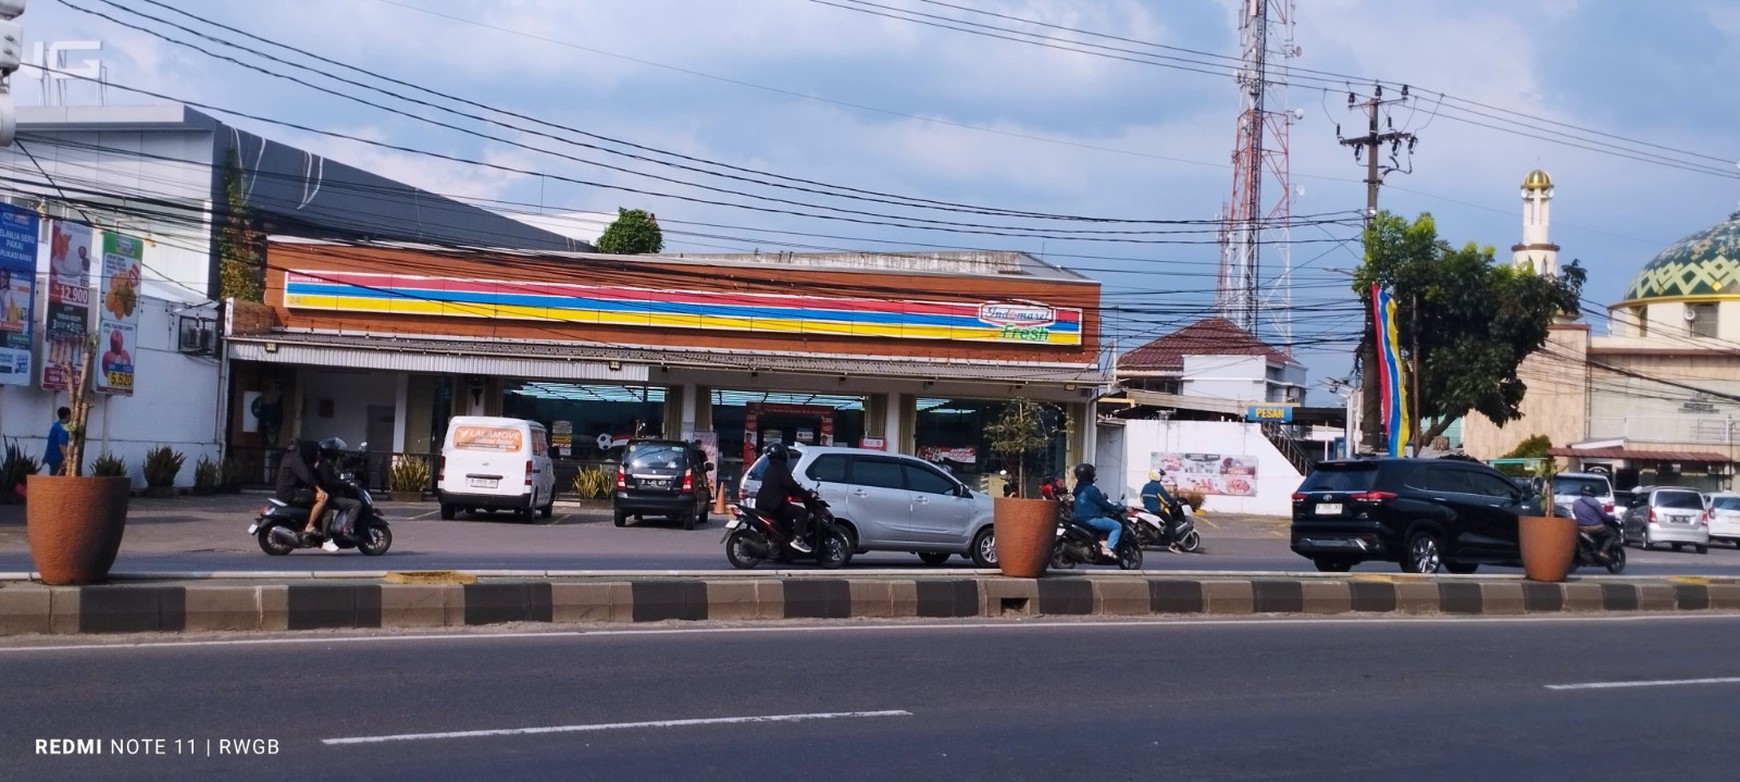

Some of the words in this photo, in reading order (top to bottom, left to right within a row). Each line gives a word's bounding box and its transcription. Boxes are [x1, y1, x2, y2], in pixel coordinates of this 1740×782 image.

[985, 306, 1049, 321] Indomaret
[1001, 324, 1049, 341] Fresh
[1255, 407, 1284, 419] PESAN
[470, 429, 520, 440] LALAMOVE
